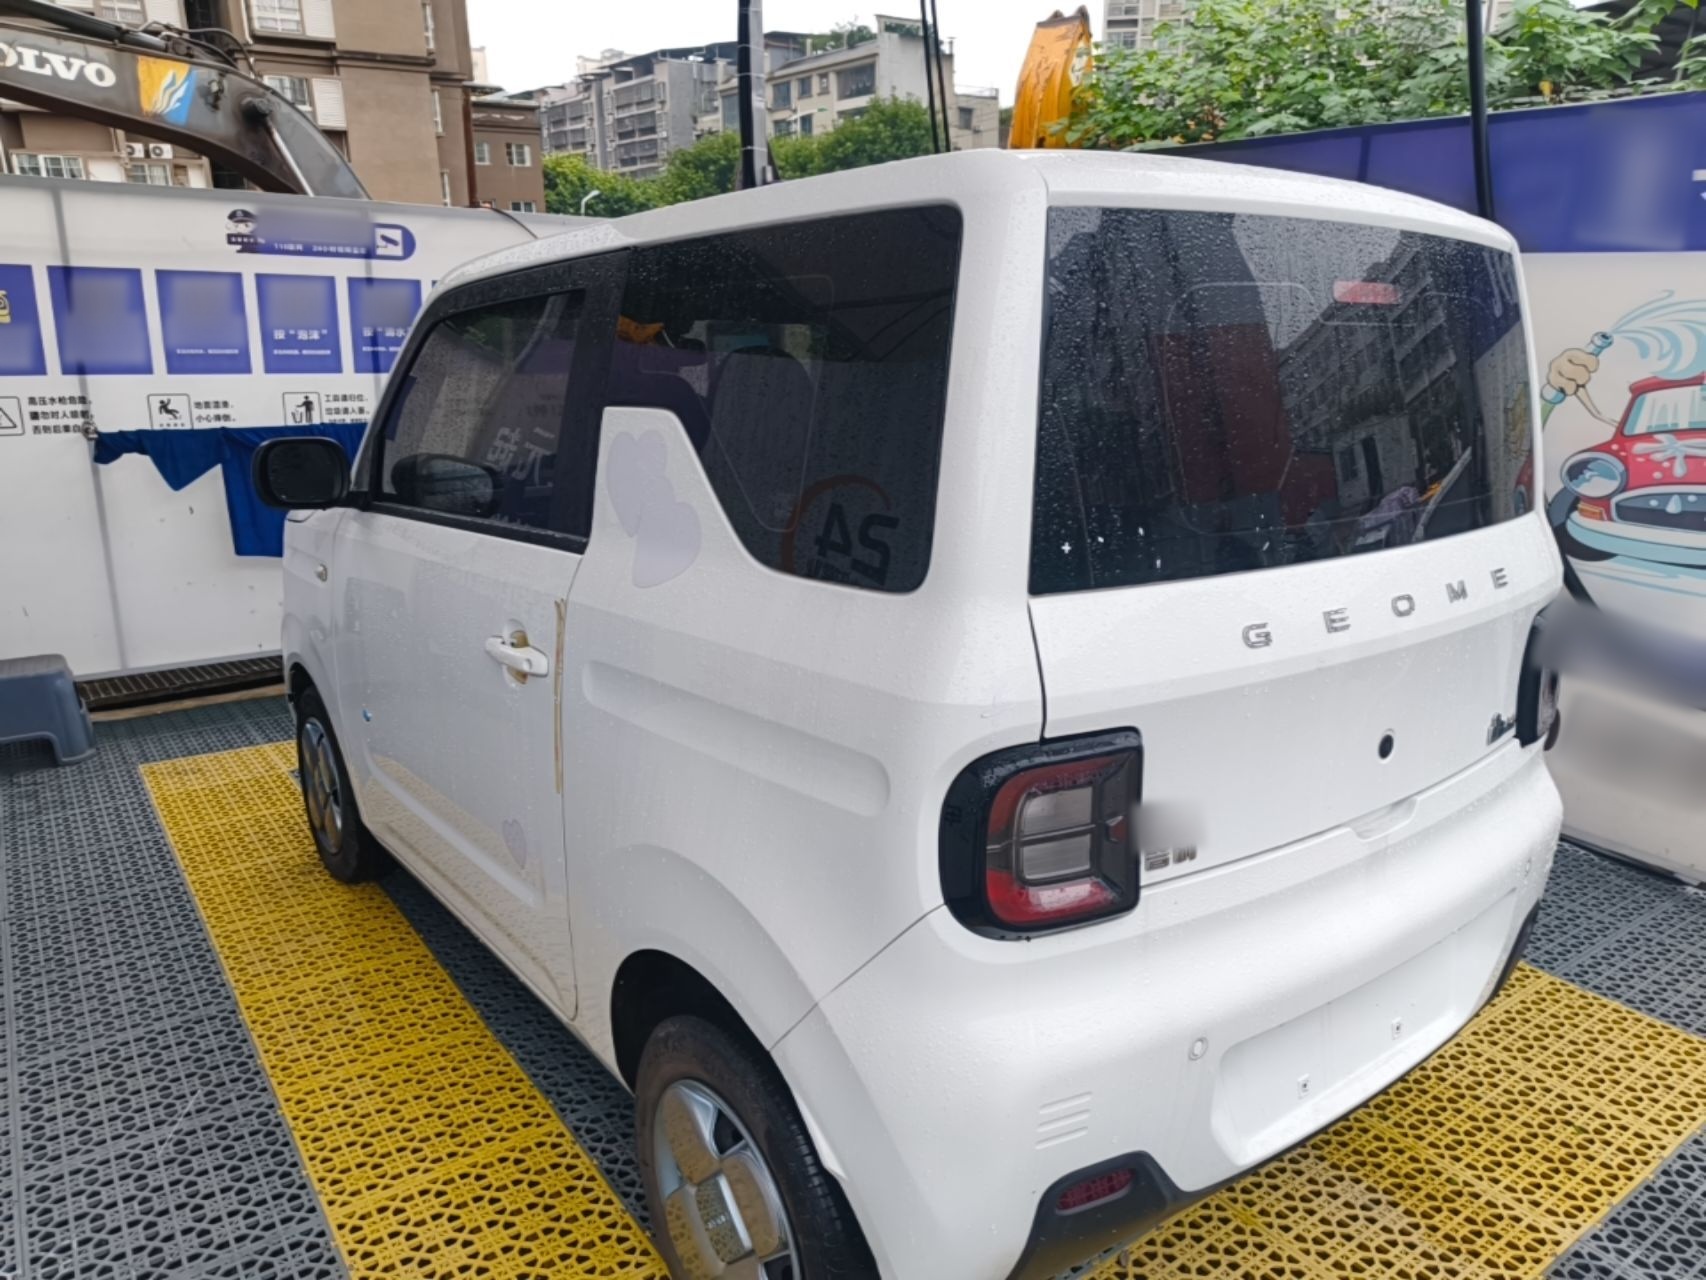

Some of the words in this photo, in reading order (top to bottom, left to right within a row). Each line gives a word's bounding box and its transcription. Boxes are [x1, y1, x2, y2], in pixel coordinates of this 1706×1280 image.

[33, 424, 84, 435] 否则后果自
[1242, 567, 1508, 649] GEOME
